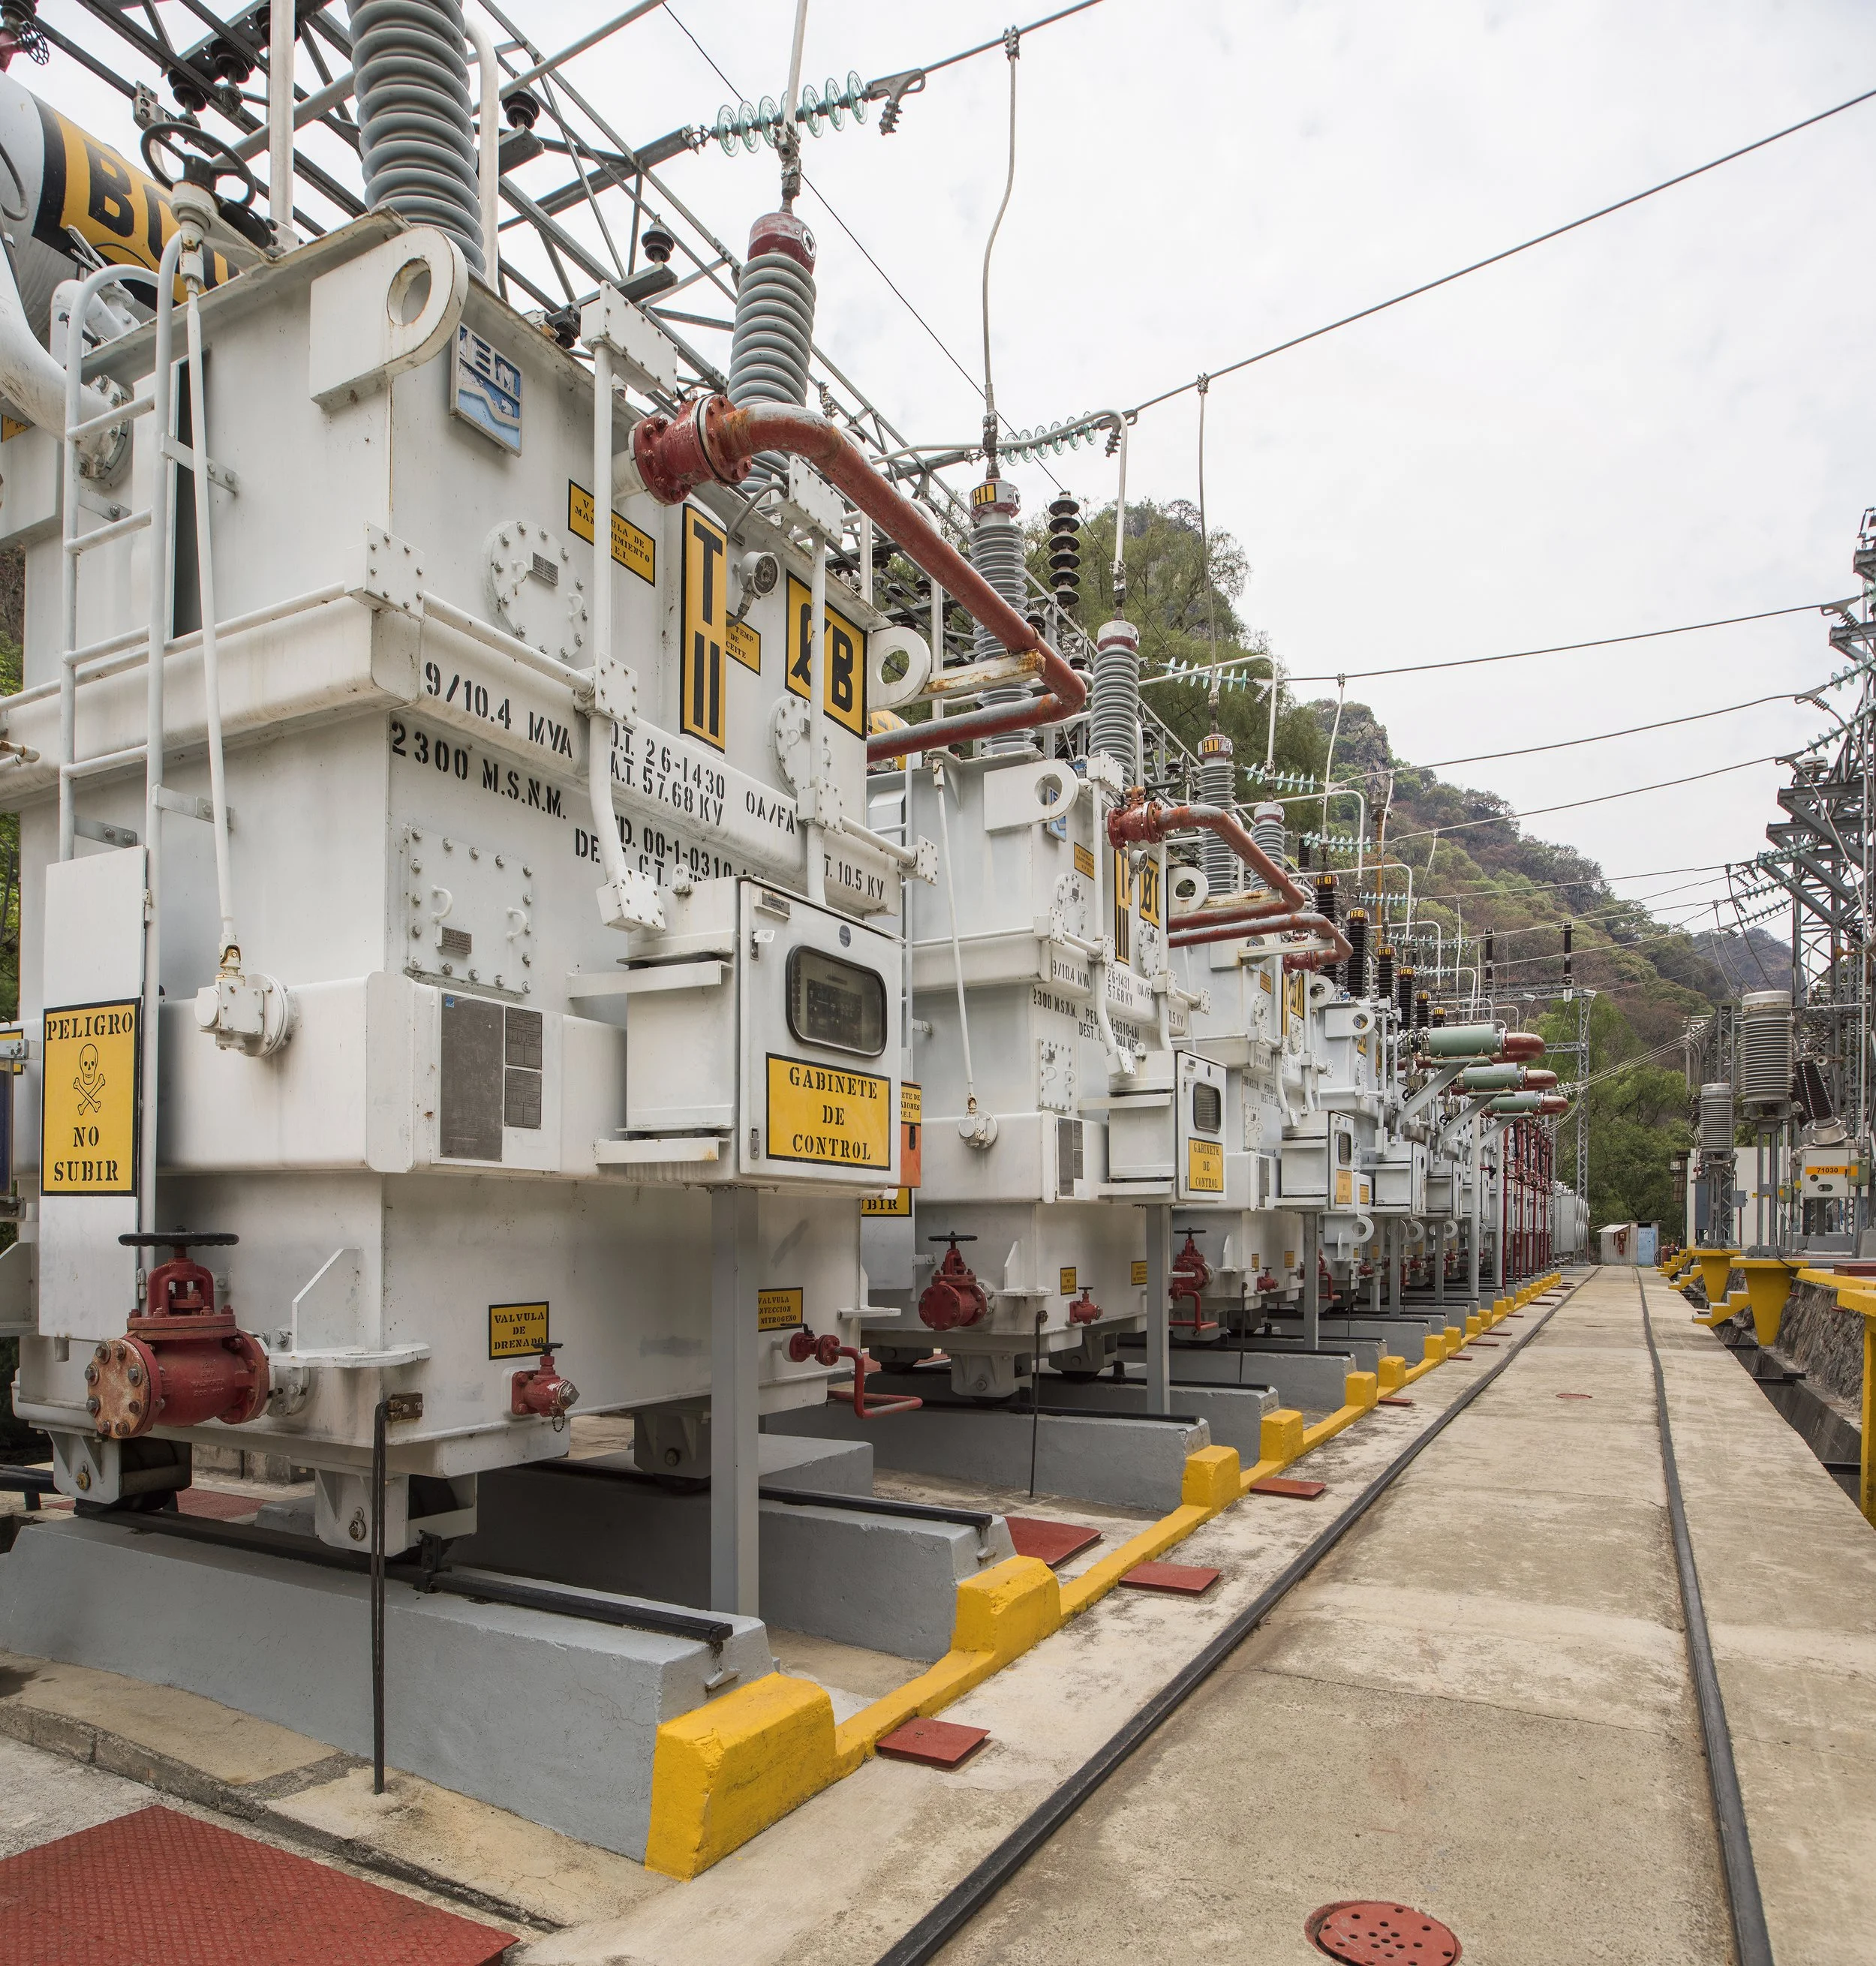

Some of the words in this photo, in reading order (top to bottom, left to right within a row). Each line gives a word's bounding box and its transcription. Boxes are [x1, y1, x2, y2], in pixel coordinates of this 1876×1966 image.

[634, 535, 645, 549] DE
[730, 633, 739, 643] DE
[726, 641, 746, 659] CEITE
[425, 662, 512, 730] 9/10.4
[528, 711, 573, 759] MVA
[391, 721, 468, 780] 2300
[483, 758, 567, 820] M.S.N.M.
[646, 738, 725, 800] 26-1430
[642, 765, 693, 813] 57.68
[699, 793, 723, 826] KV
[838, 861, 862, 891] 10.5
[867, 875, 885, 900] KV
[47, 1012, 134, 1041] PELIGRO
[789, 1066, 878, 1099] GABINETE
[913, 1093, 921, 1102] DE
[822, 1105, 845, 1126] DE
[73, 1126, 100, 1147] NO
[792, 1133, 871, 1160] CONTROL
[1193, 1142, 1219, 1156] GABINETE
[53, 1160, 119, 1182] SUBIR
[1202, 1160, 1210, 1171] DE
[1195, 1177, 1219, 1189] CONTROL
[494, 1312, 545, 1324] VALVULA
[759, 1306, 792, 1315] NYECCION
[760, 1315, 797, 1324] NITROGENO
[513, 1326, 526, 1335] DE
[494, 1336, 544, 1350] DRENADO
